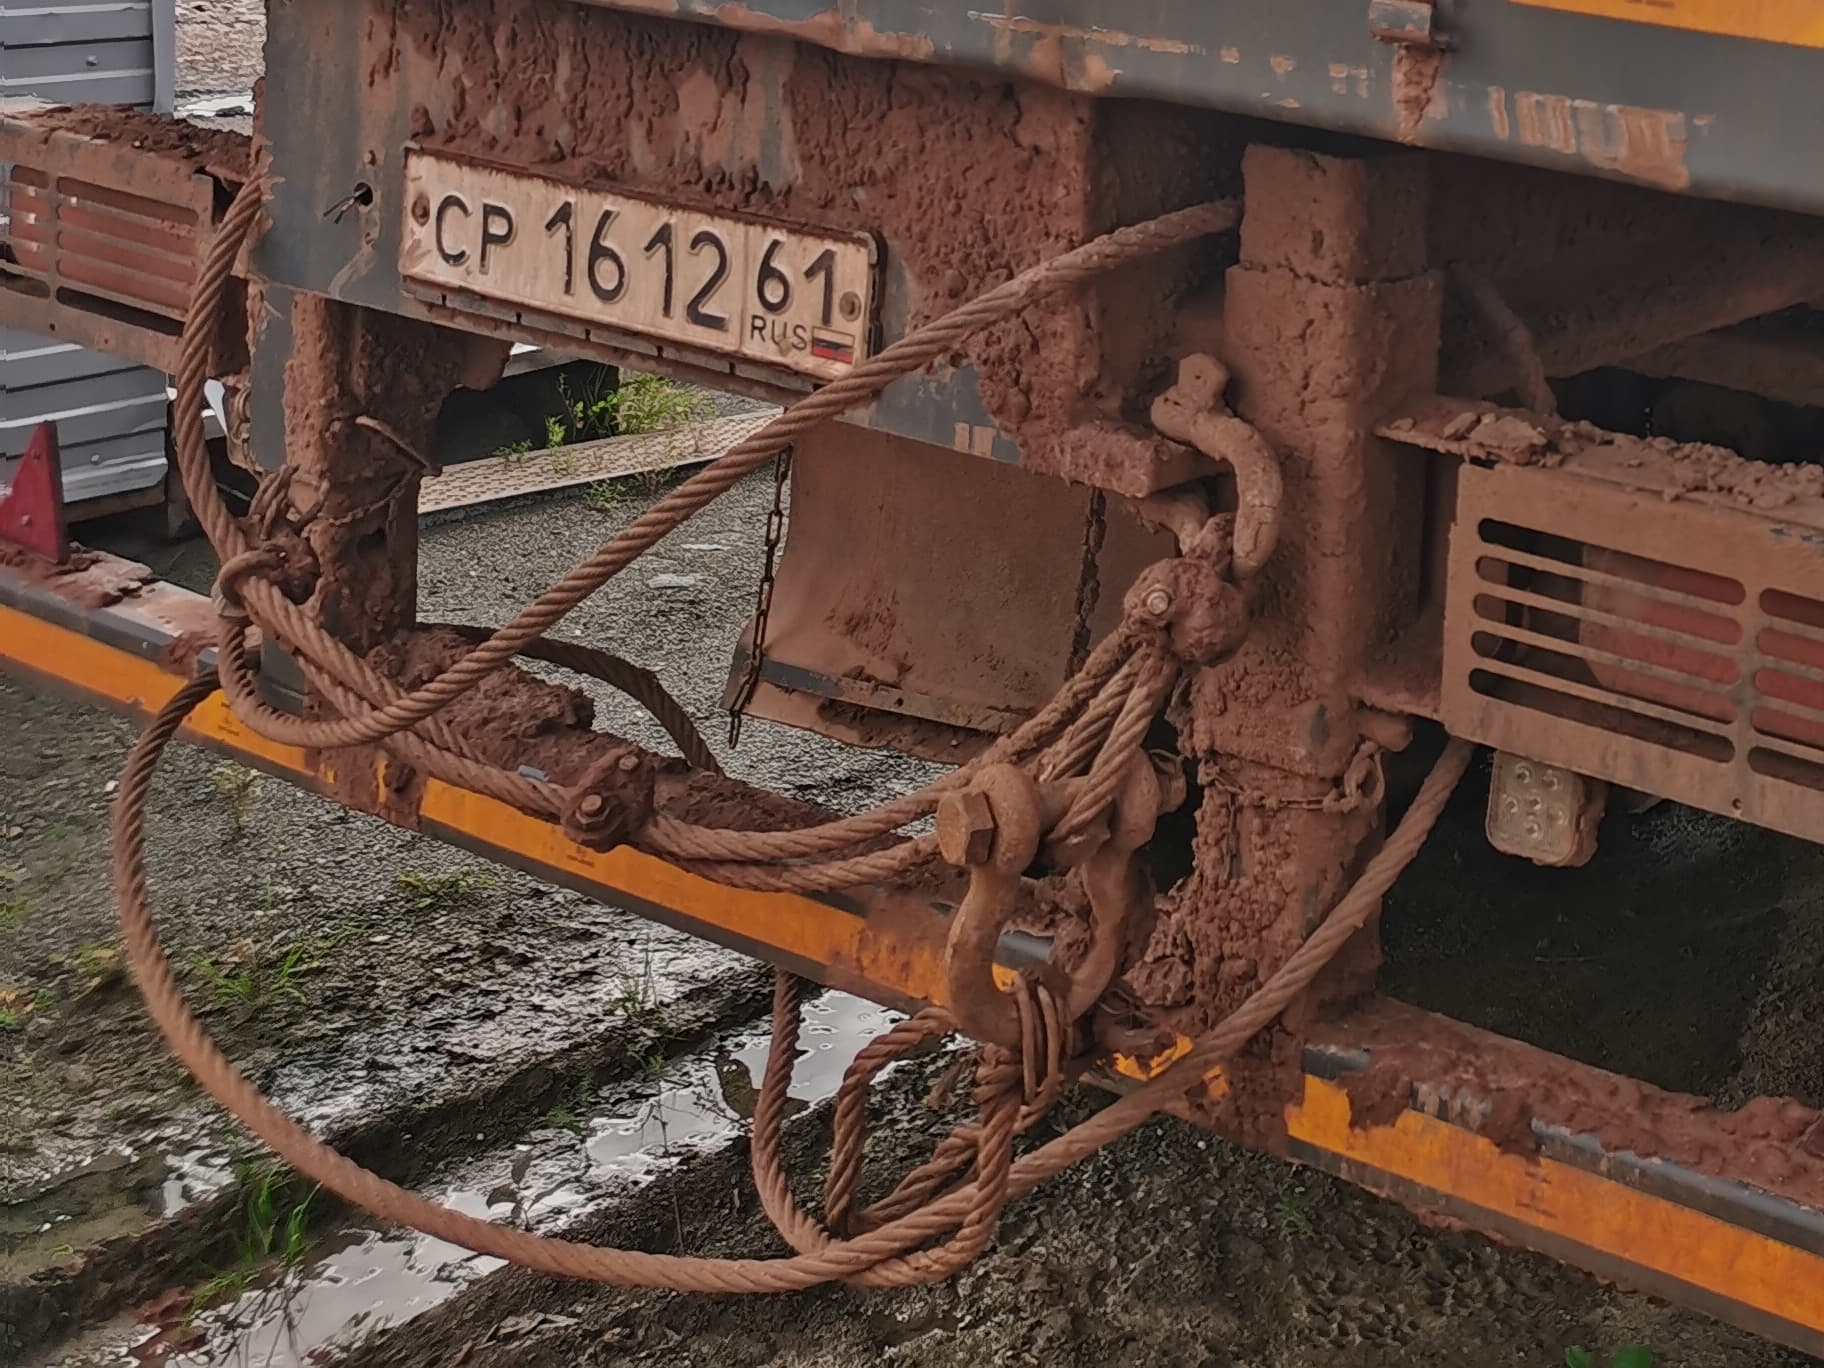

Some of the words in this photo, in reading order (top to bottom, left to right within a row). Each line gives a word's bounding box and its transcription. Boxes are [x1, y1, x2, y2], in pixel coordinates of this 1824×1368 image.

[544, 199, 730, 329] 1612
[757, 238, 838, 326] 61
[750, 313, 808, 351] RUS
